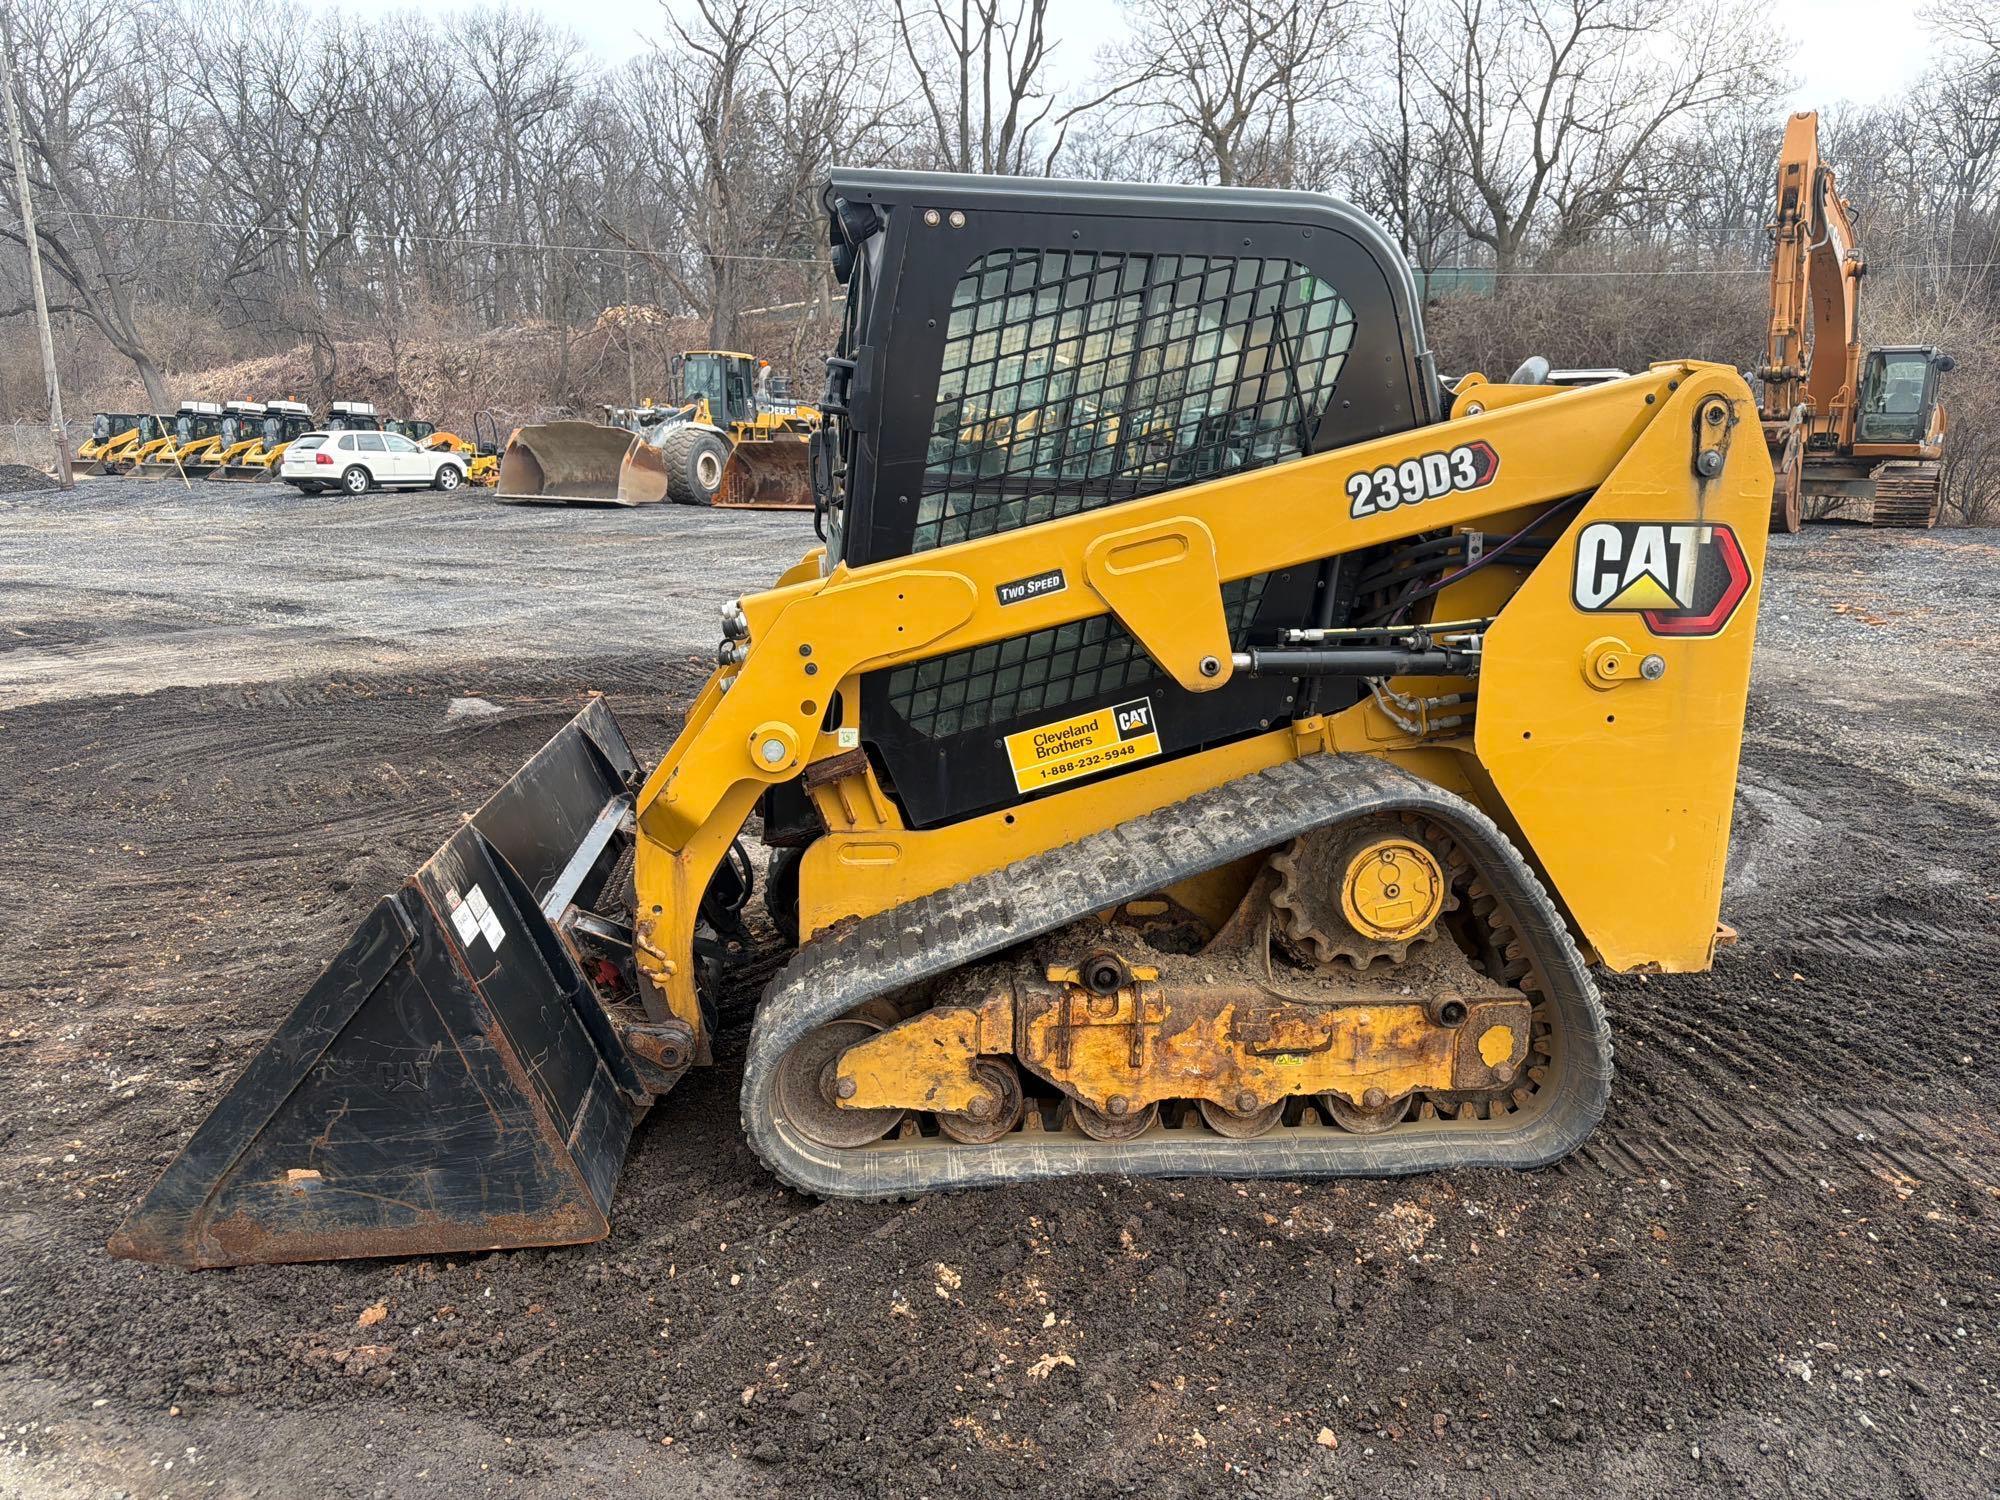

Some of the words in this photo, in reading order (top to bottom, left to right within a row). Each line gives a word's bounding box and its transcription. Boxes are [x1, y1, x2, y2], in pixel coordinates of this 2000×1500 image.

[1348, 447, 1477, 516] 239D3
[1575, 523, 1712, 609] CAT
[1033, 719, 1099, 747] Cleveland
[1118, 707, 1149, 731] CAT
[1036, 735, 1093, 759] Brothers
[1040, 745, 1135, 778] 1-888-232-5948
[377, 1062, 431, 1091] CAT
